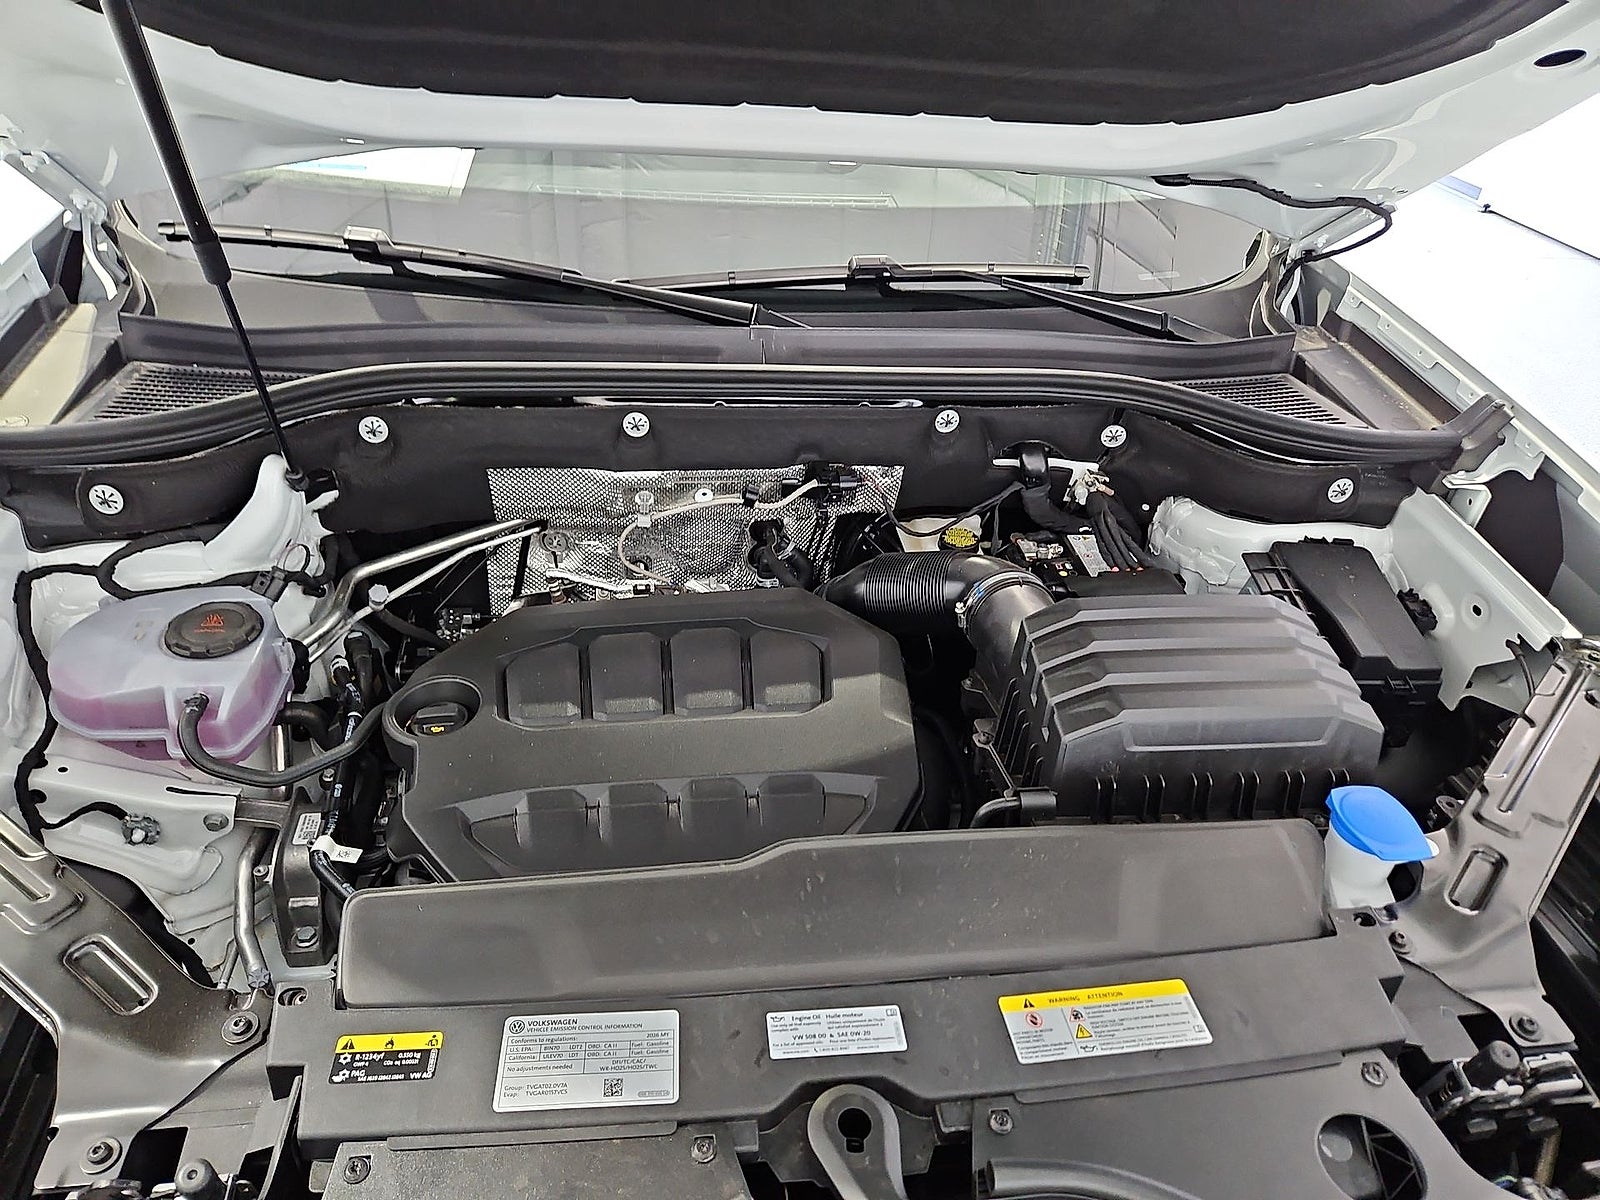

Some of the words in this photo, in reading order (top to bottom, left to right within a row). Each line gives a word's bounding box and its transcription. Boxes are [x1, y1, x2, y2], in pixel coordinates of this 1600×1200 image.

[1048, 996, 1082, 1004] WARNING
[1087, 992, 1123, 1000] ATTENTION
[527, 1019, 578, 1027] VOLKSWAGEN
[791, 1015, 812, 1023] Engine
[792, 1033, 803, 1041] VW
[354, 1052, 385, 1062] R-1234yf
[414, 1051, 421, 1059] kg
[350, 1069, 366, 1077] PAG
[410, 1072, 421, 1080] VW
[422, 1071, 434, 1079] AG
